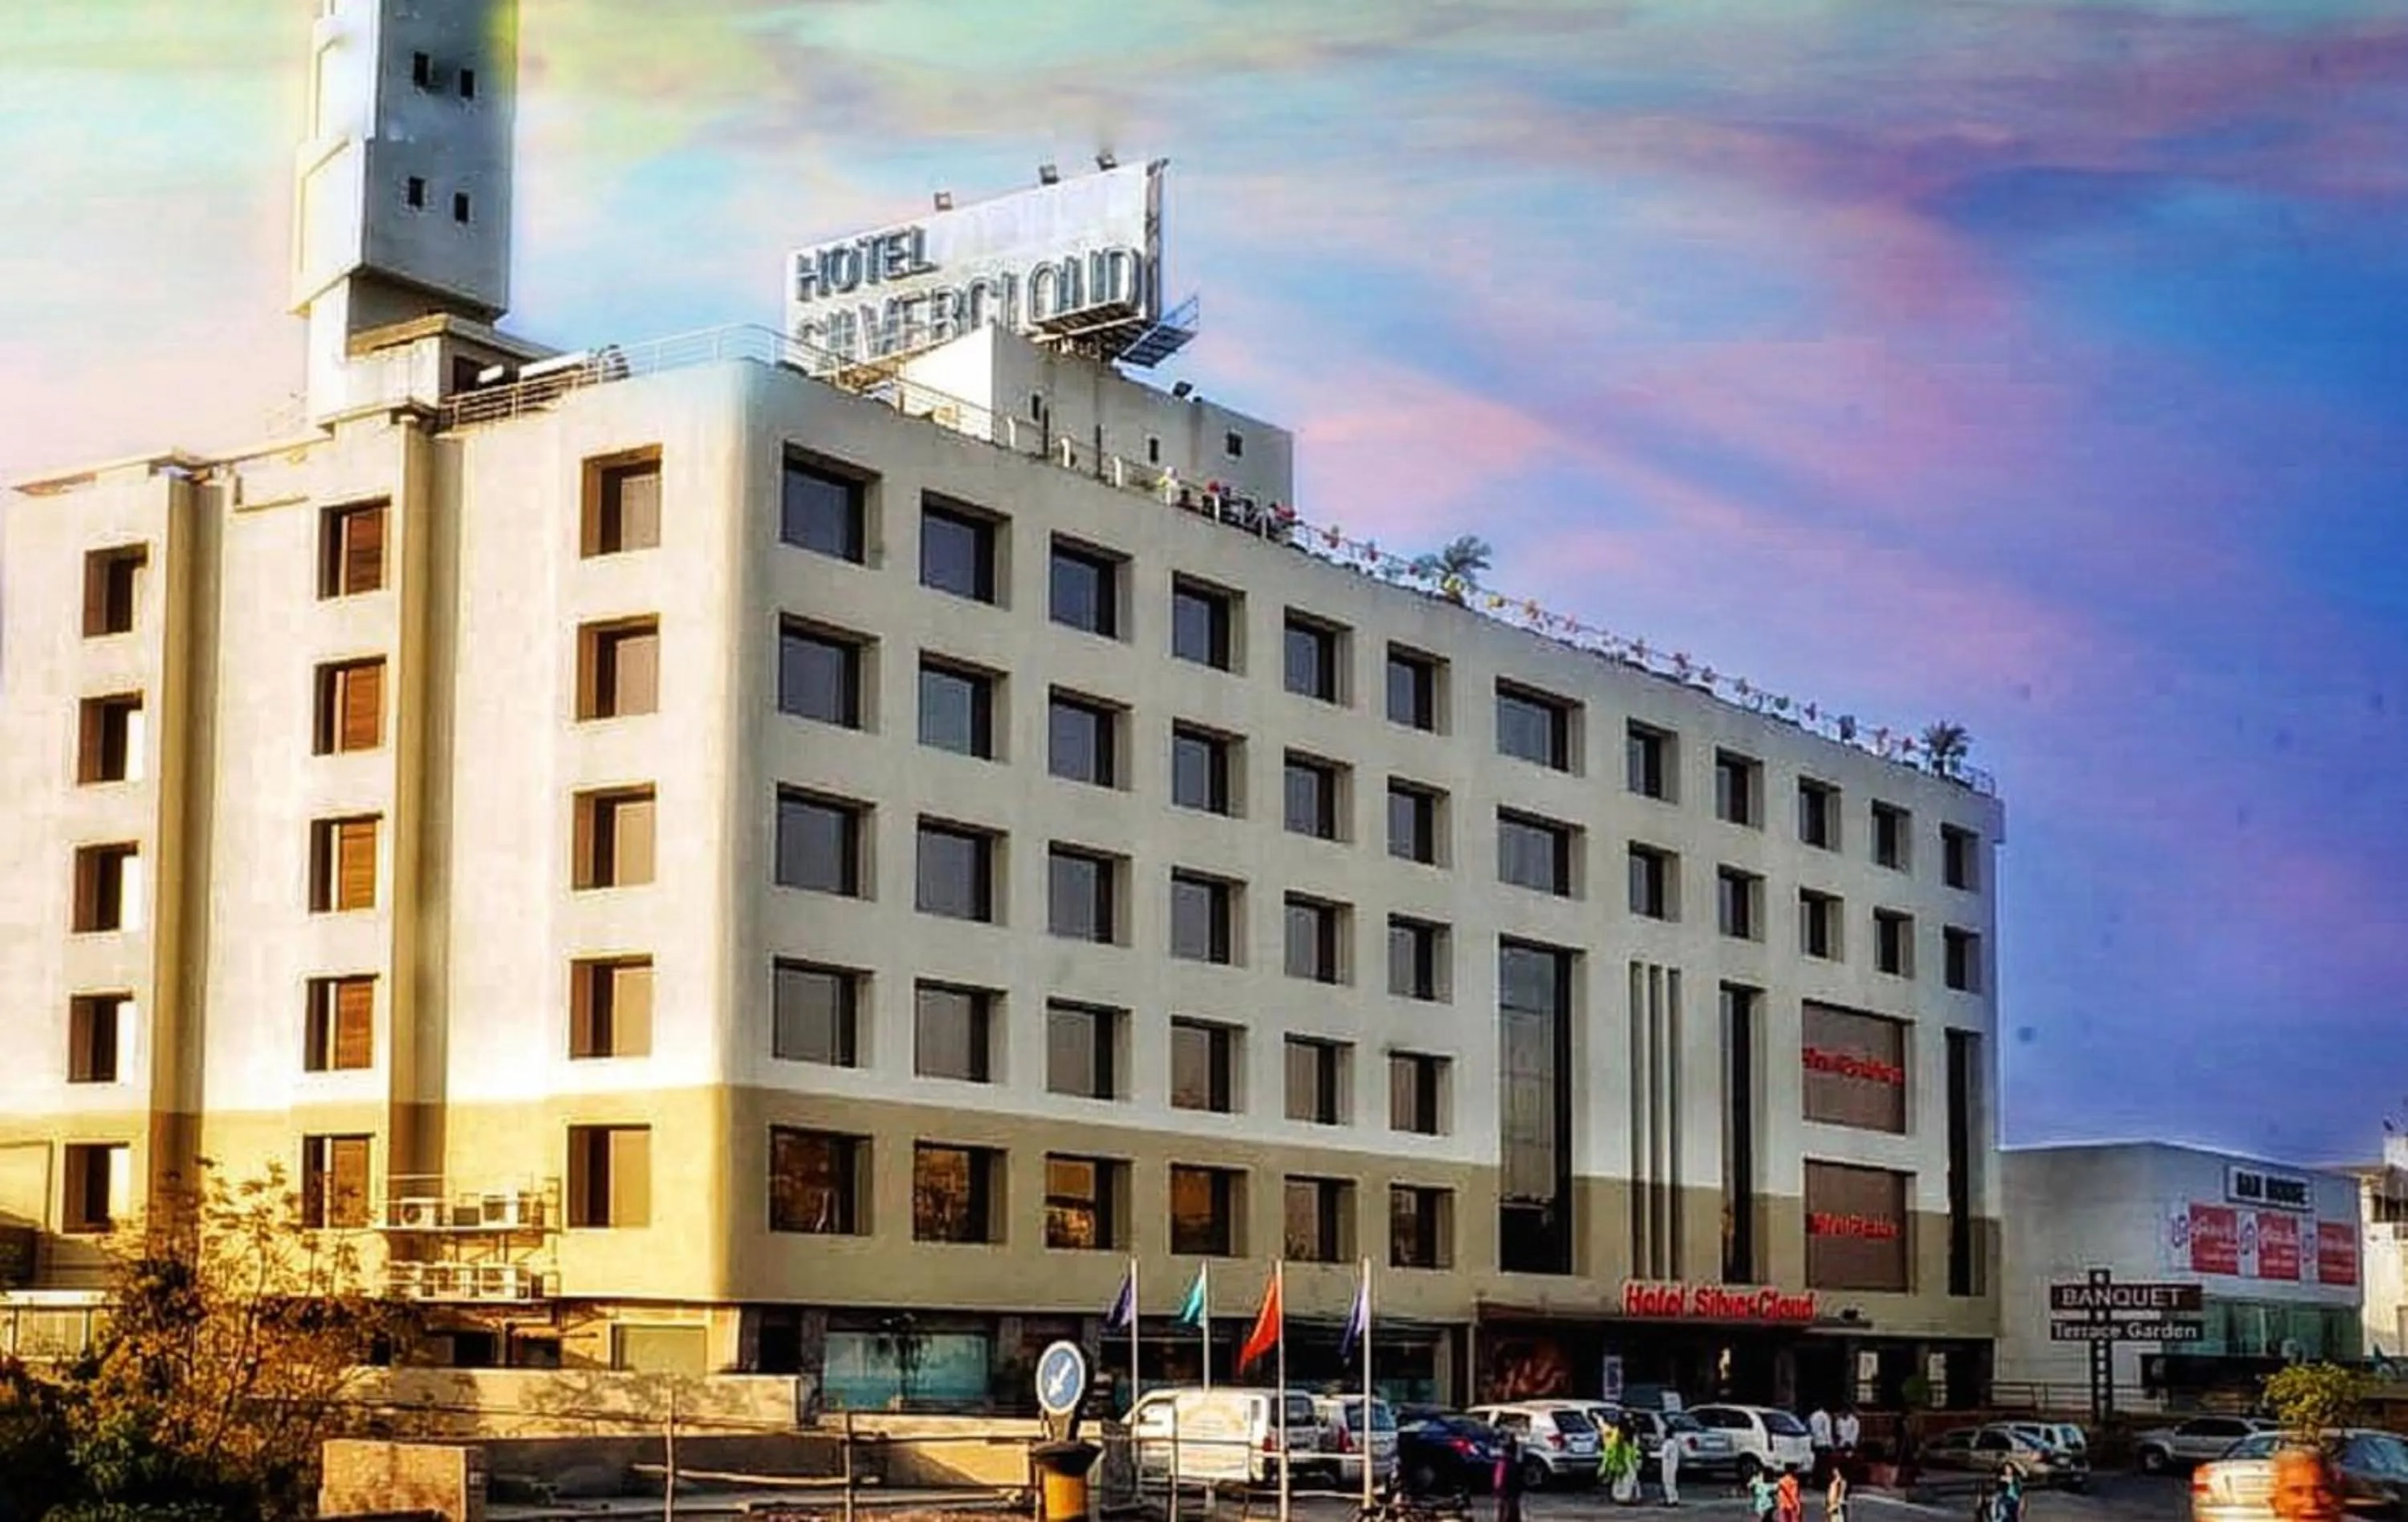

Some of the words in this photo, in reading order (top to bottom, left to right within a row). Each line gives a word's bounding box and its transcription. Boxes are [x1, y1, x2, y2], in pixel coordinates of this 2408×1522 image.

[796, 226, 936, 302] HOTEL
[1625, 1282, 1686, 1317] Hotel
[2062, 1287, 2181, 1307] BANQUET
[2054, 1323, 2121, 1338] Terrace
[2127, 1322, 2197, 1339] Garden
